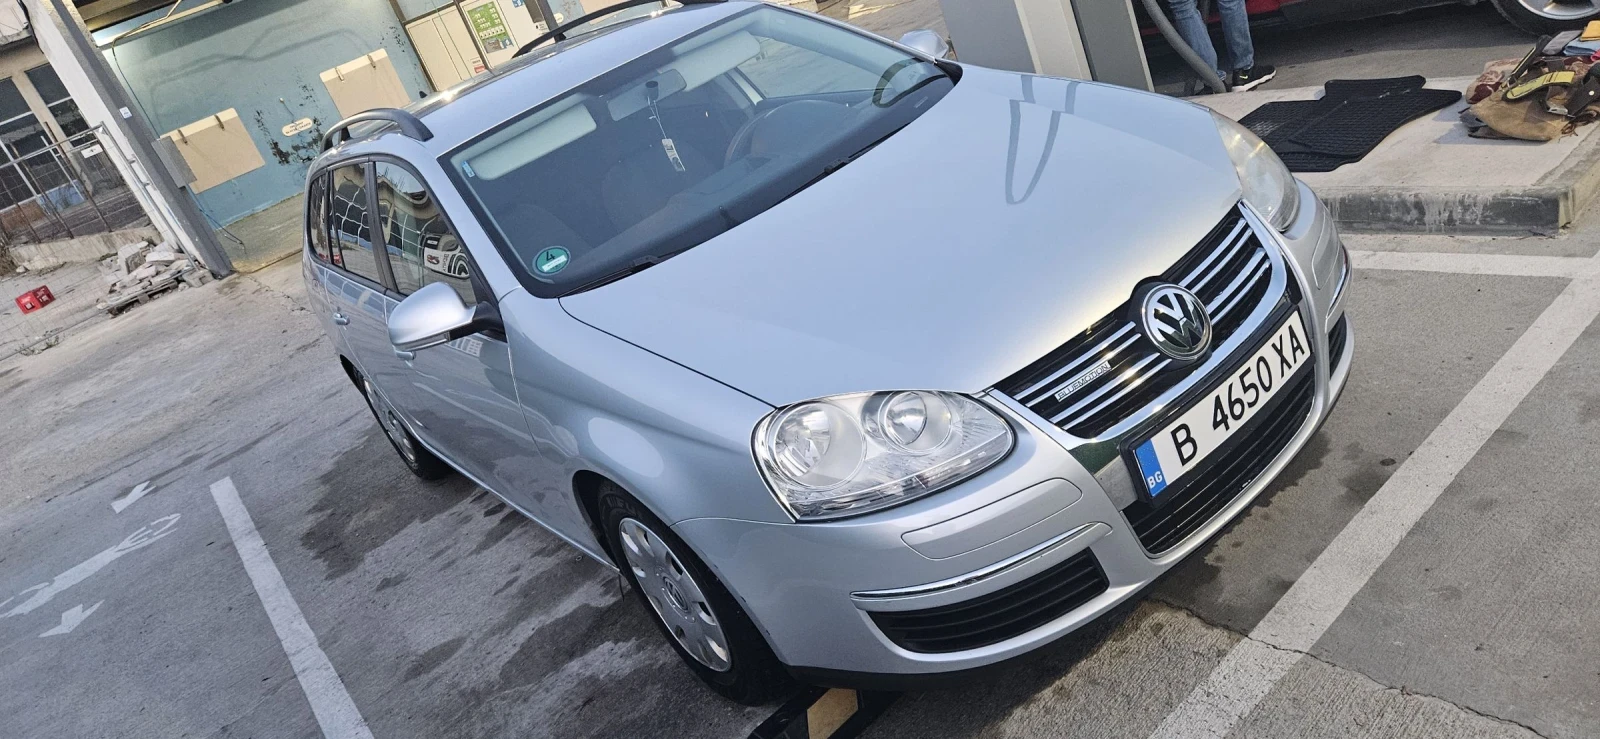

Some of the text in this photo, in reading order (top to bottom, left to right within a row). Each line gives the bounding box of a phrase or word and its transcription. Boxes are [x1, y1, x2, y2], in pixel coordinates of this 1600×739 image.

[1145, 286, 1209, 356] VW
[1057, 363, 1110, 400] BLUEMOTION
[1170, 324, 1305, 466] B 4650 XA
[1147, 471, 1163, 489] BG
